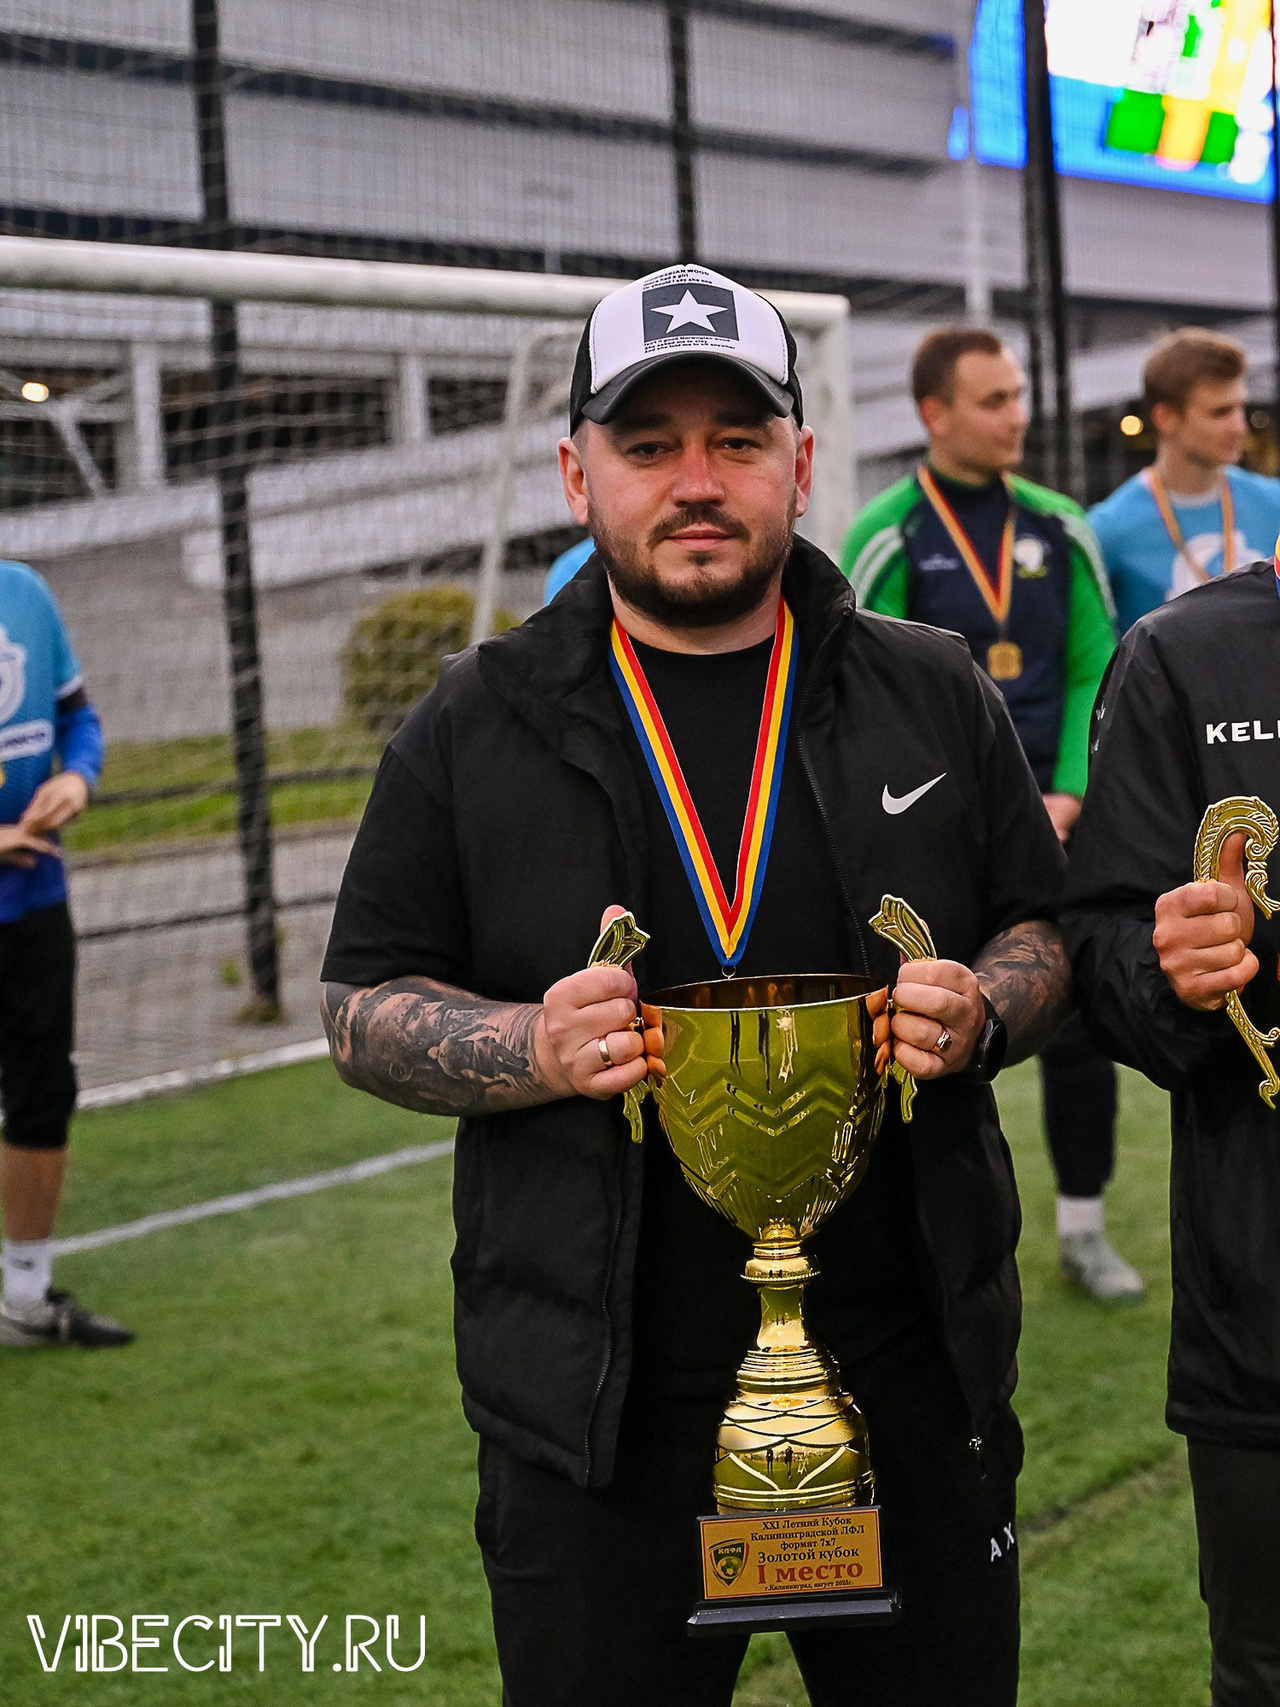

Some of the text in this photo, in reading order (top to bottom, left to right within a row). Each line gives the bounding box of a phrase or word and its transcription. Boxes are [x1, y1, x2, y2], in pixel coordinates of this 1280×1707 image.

[782, 1518, 819, 1529] Летний
[822, 1517, 852, 1527] Кубок
[750, 1525, 865, 1541] Калининградской ЛФЛ
[780, 1540, 817, 1551] формат
[758, 1547, 859, 1564] Золотой кубок
[775, 1563, 863, 1583] место
